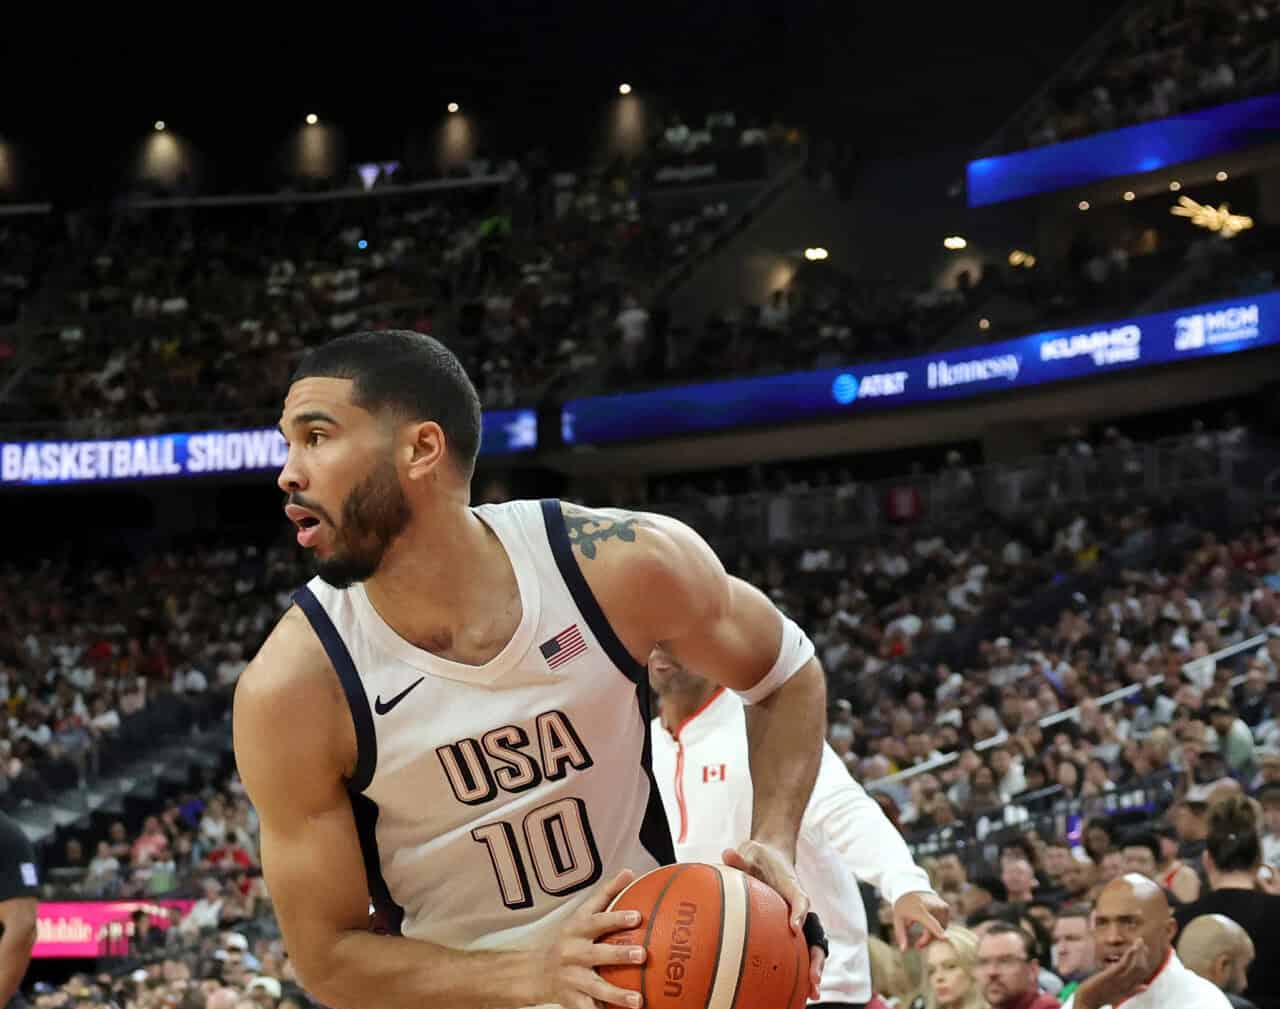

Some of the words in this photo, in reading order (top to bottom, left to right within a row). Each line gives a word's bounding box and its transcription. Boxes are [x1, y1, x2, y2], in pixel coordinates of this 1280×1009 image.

[858, 371, 908, 398] AT&T
[927, 354, 1019, 390] Hennessy
[1, 436, 180, 482] BASKETBALL
[435, 709, 594, 806] USA
[471, 796, 603, 911] 10
[663, 901, 697, 998] molten
